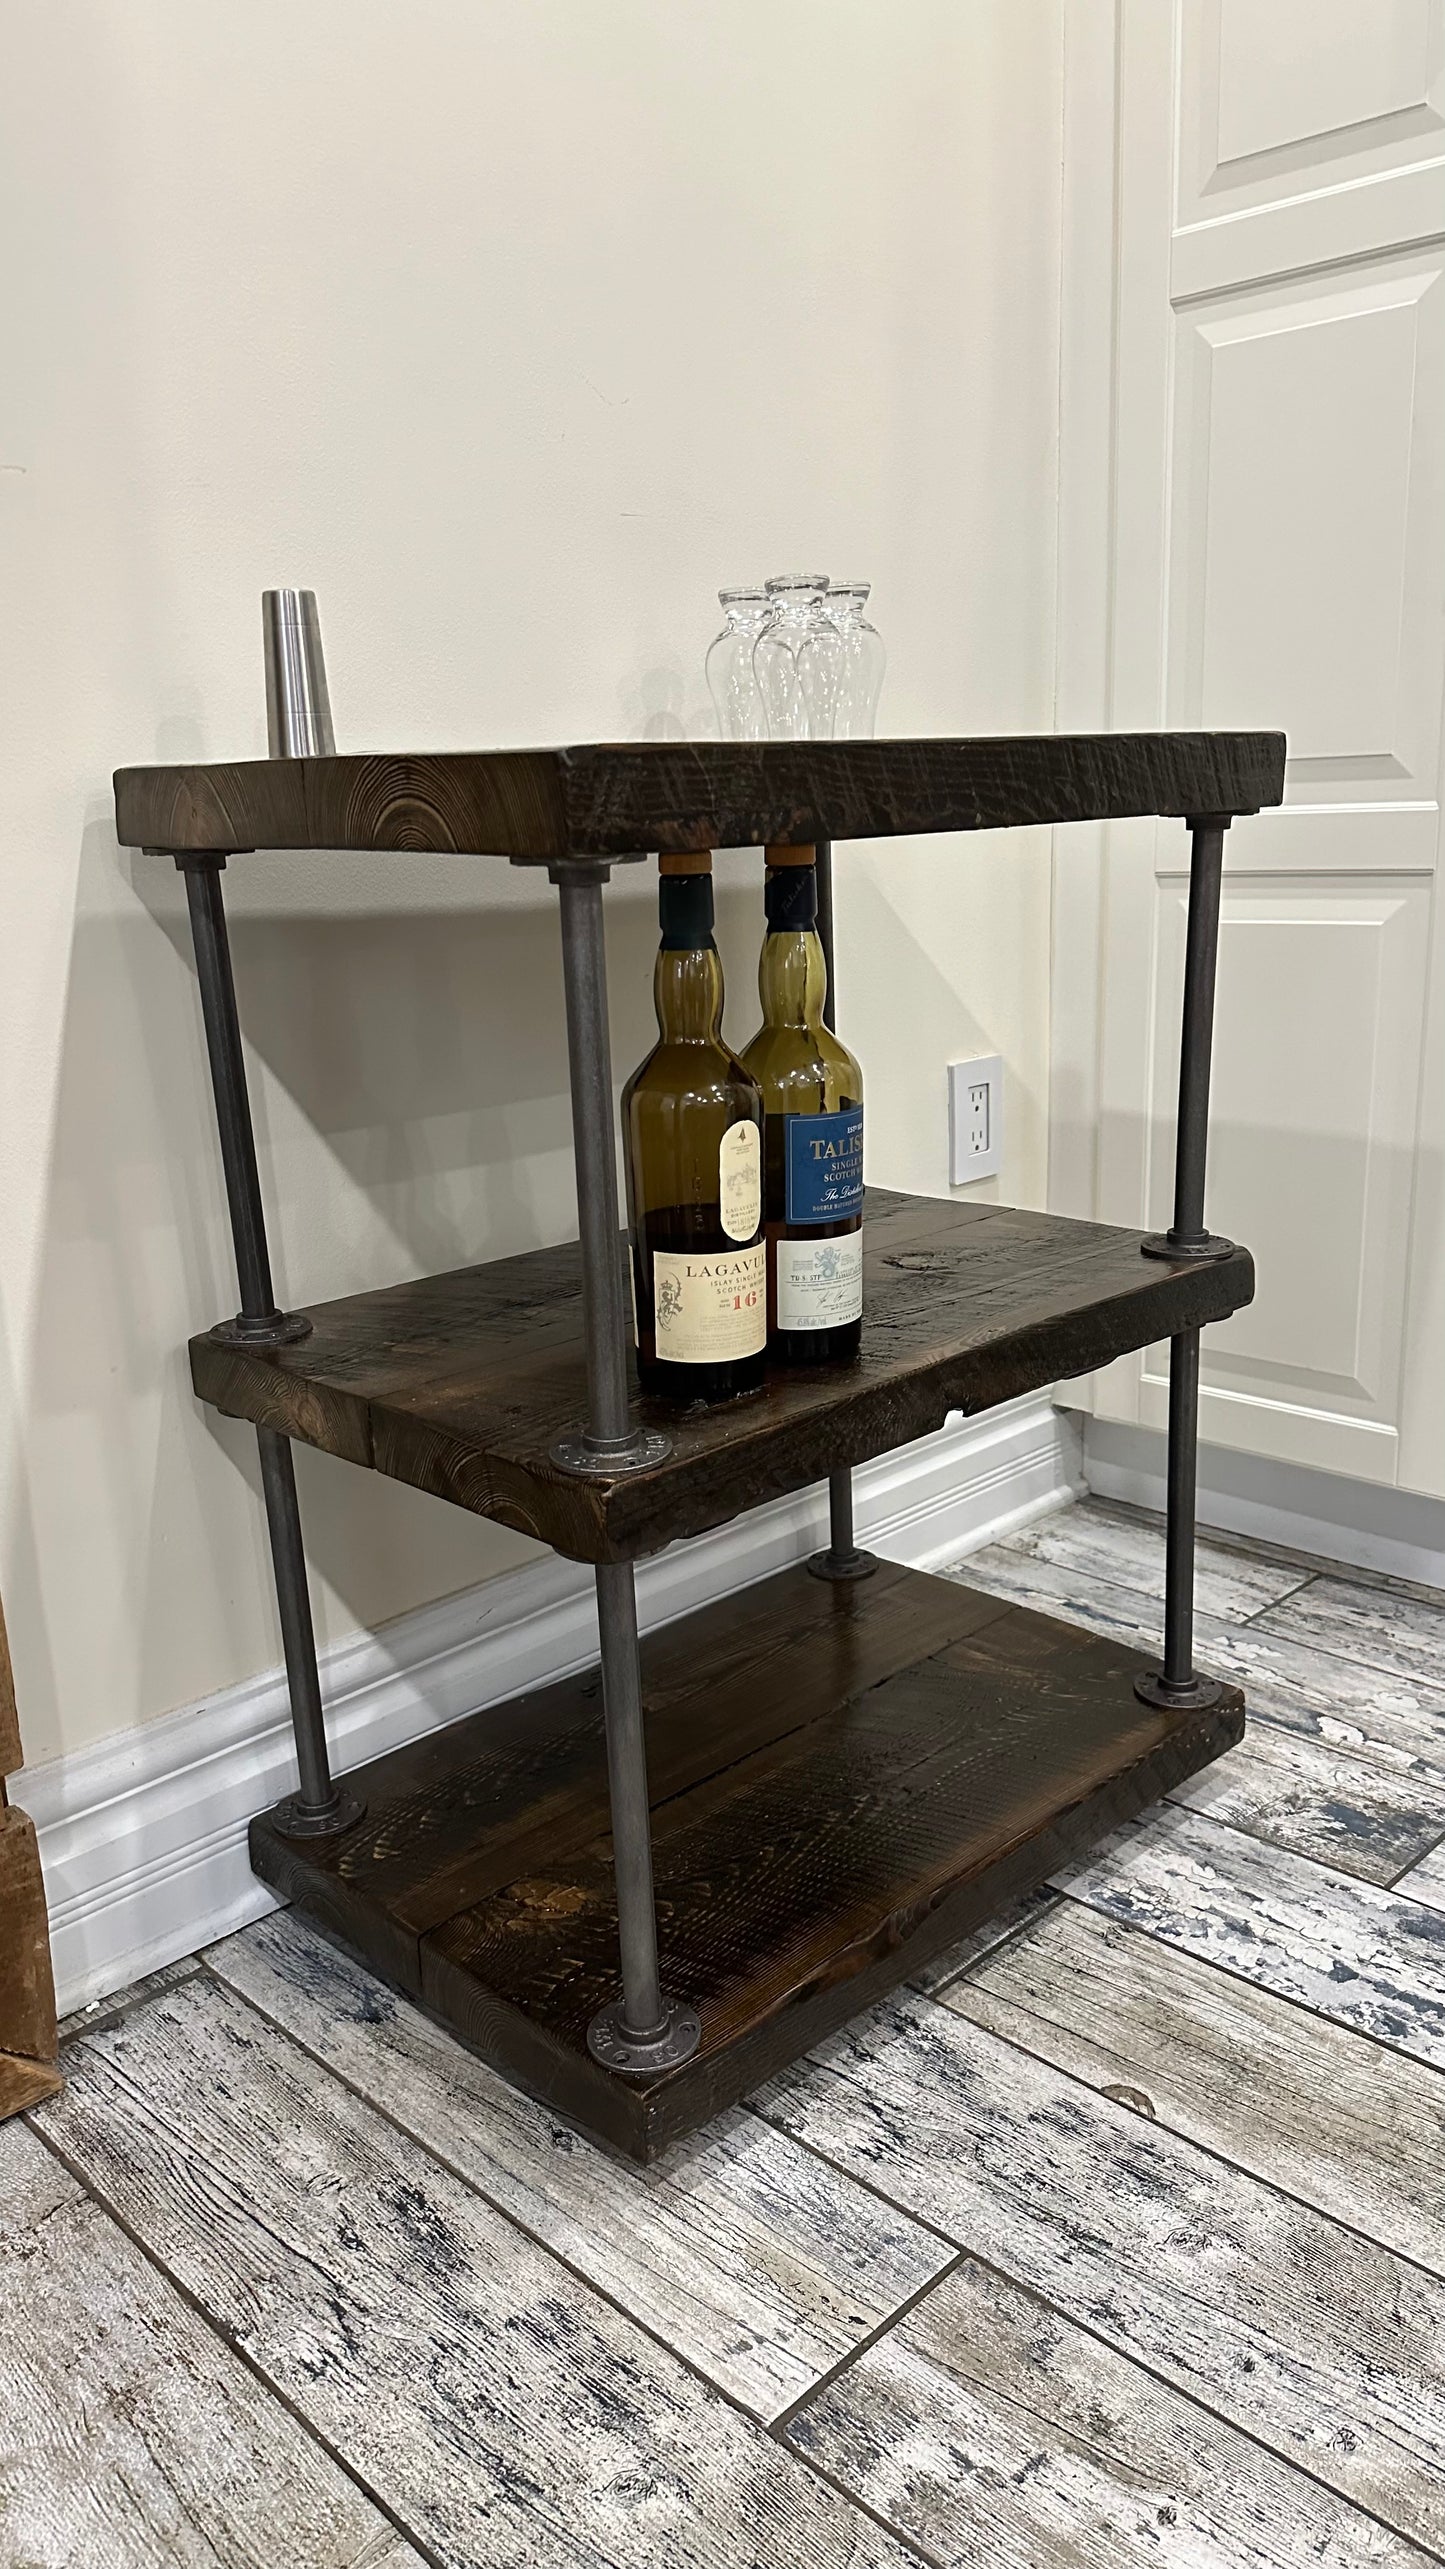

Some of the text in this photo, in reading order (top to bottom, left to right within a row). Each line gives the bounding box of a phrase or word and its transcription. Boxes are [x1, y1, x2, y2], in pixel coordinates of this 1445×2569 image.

[832, 1158, 858, 1171] SINGLE
[823, 1168, 856, 1183] SCOTCH
[820, 1187, 840, 1202] The
[710, 1279, 733, 1287] ISLAY
[716, 1284, 747, 1295] SCOTCH
[733, 1290, 757, 1311] 16
